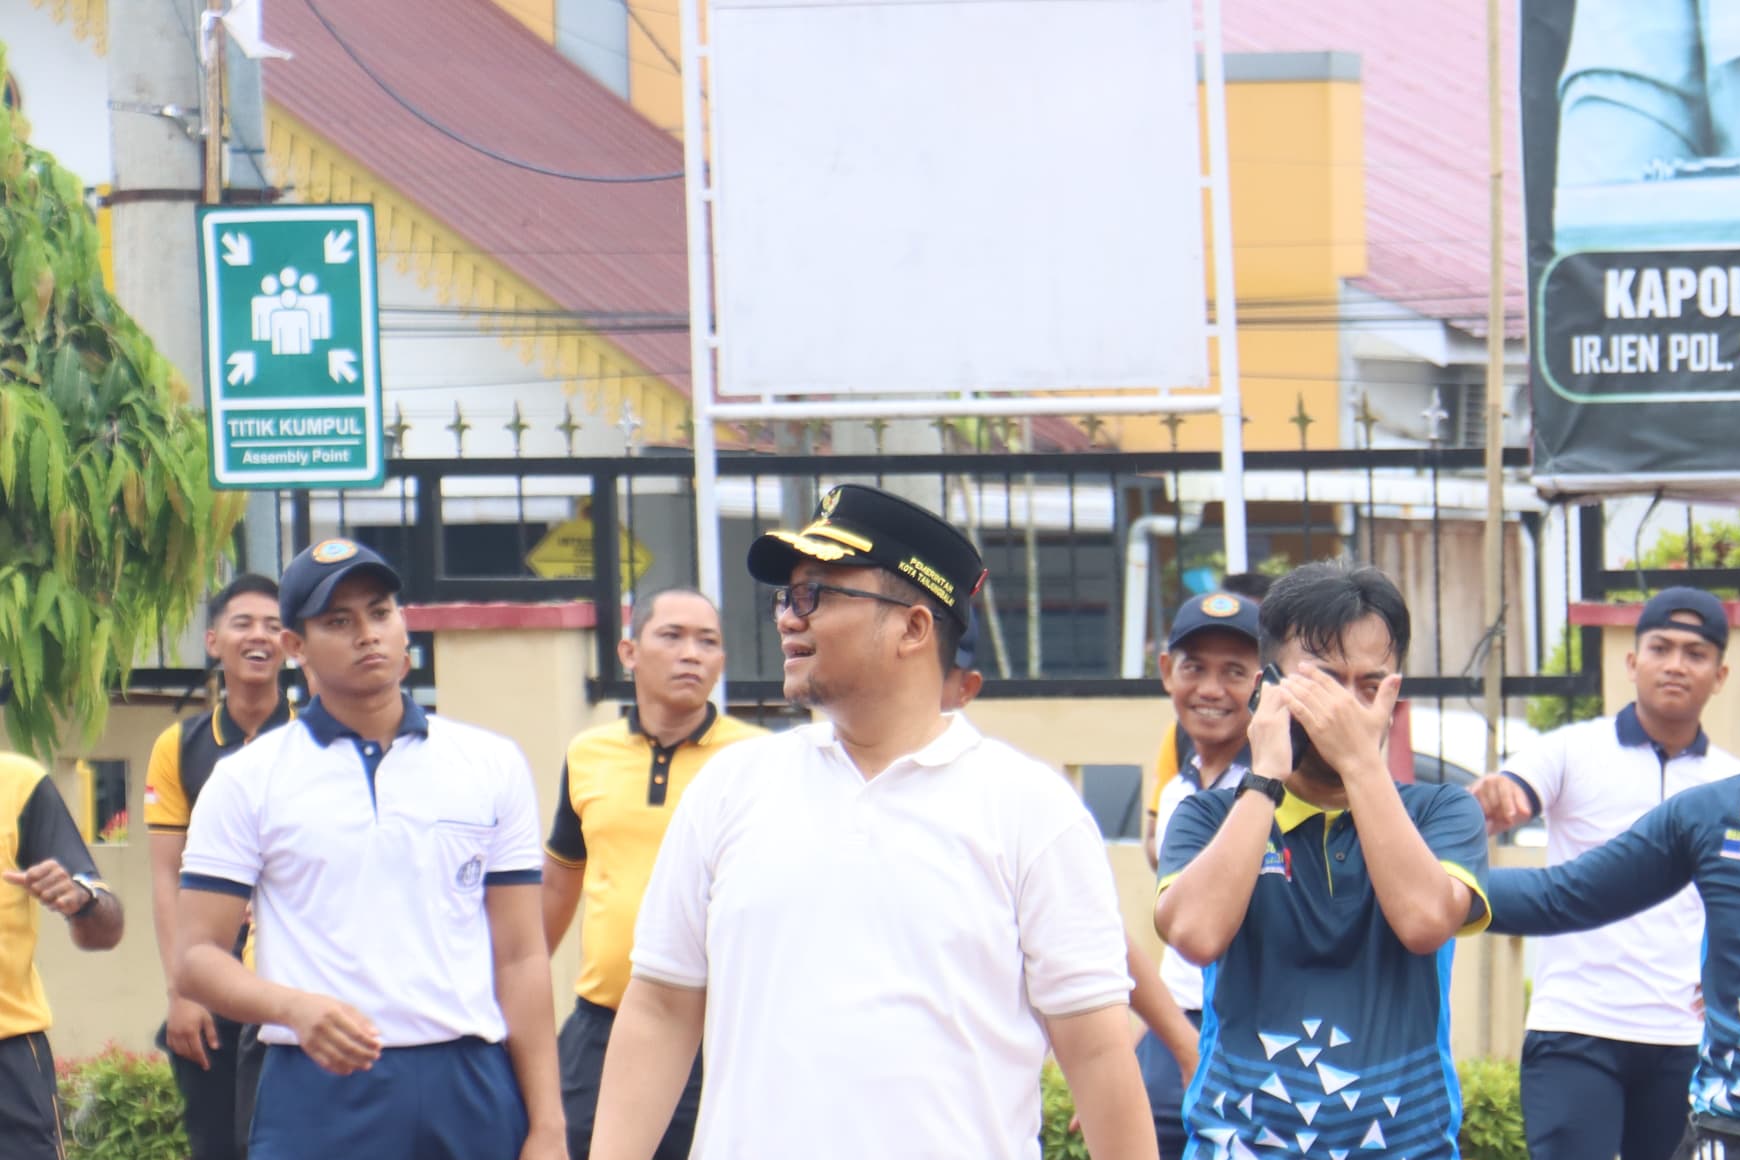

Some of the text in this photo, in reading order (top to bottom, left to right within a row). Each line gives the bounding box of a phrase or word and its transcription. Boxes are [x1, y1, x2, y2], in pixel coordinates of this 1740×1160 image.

[1571, 333, 1660, 375] IRJEN
[1668, 332, 1735, 373] POL.
[228, 416, 362, 437] TITIK KUMPUL
[242, 448, 349, 465] Assembly Point
